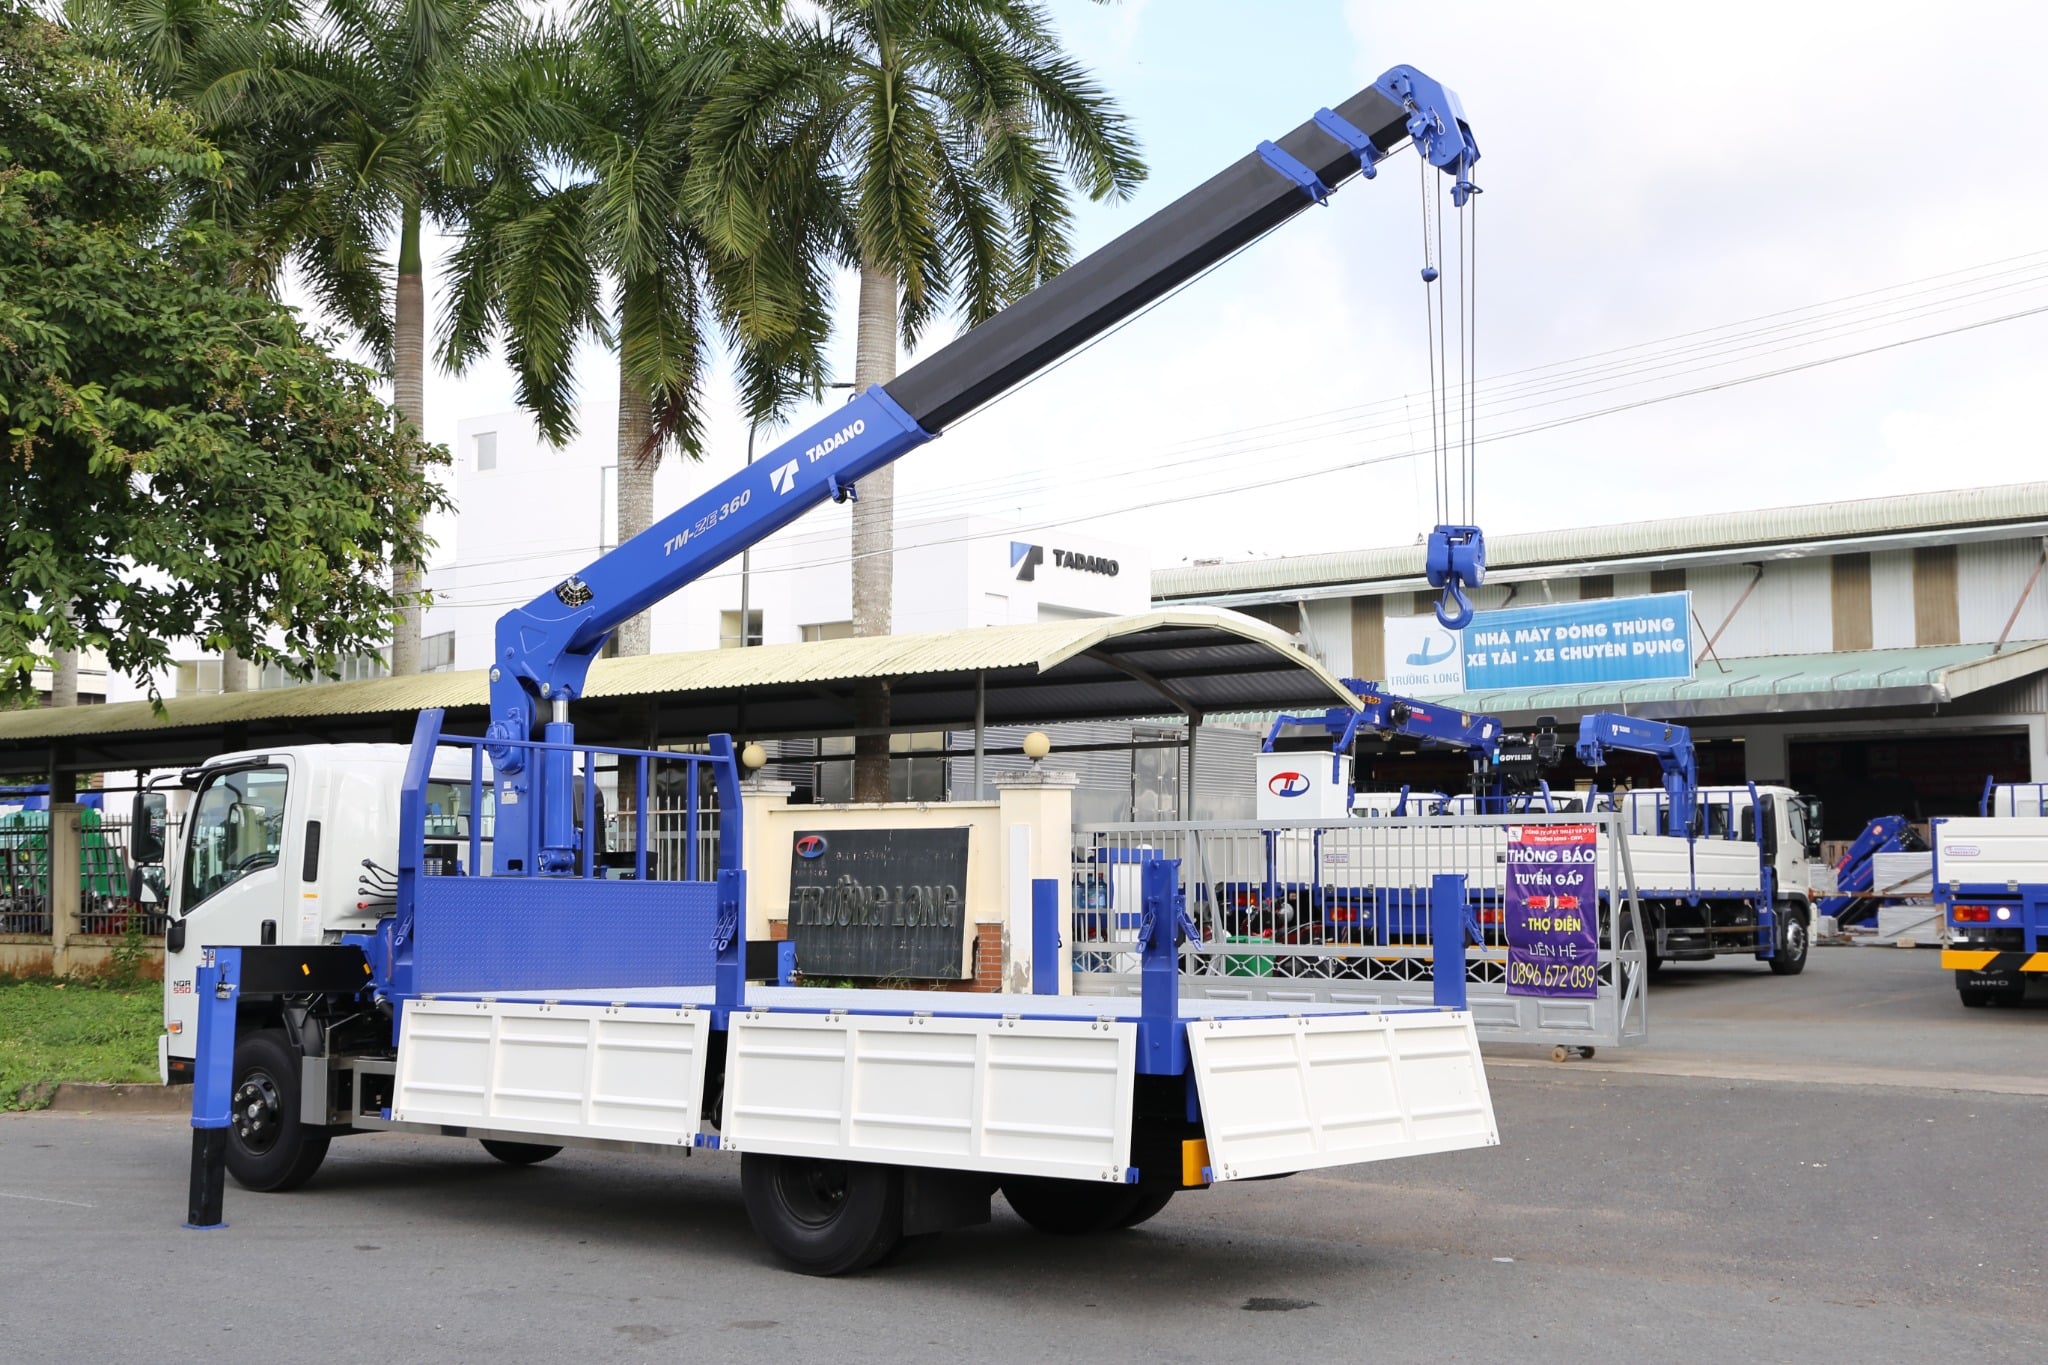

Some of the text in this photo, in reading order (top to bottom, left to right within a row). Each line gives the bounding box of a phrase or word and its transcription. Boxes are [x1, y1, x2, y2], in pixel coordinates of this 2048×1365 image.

[805, 419, 865, 463] TADANO
[1053, 549, 1119, 577] TADANO
[1515, 624, 1552, 644] MÁY
[1556, 621, 1608, 641] ĐÓNG
[1614, 615, 1675, 634] THÙNG
[1466, 653, 1487, 668] XE
[1533, 648, 1555, 664] XE
[1559, 642, 1628, 661] CHUYÊN
[1632, 639, 1685, 659] DỤNG
[1433, 672, 1460, 685] LONG
[1508, 846, 1596, 862] THÔNG BÁO
[1515, 868, 1584, 886] TUYỂN GẤP
[891, 884, 959, 927] LONG
[1528, 915, 1551, 935] THỢ
[1554, 914, 1582, 936] ĐIỆN
[1528, 941, 1577, 960] LIÊN HỆ
[1511, 961, 1595, 989] 0896 672 039
